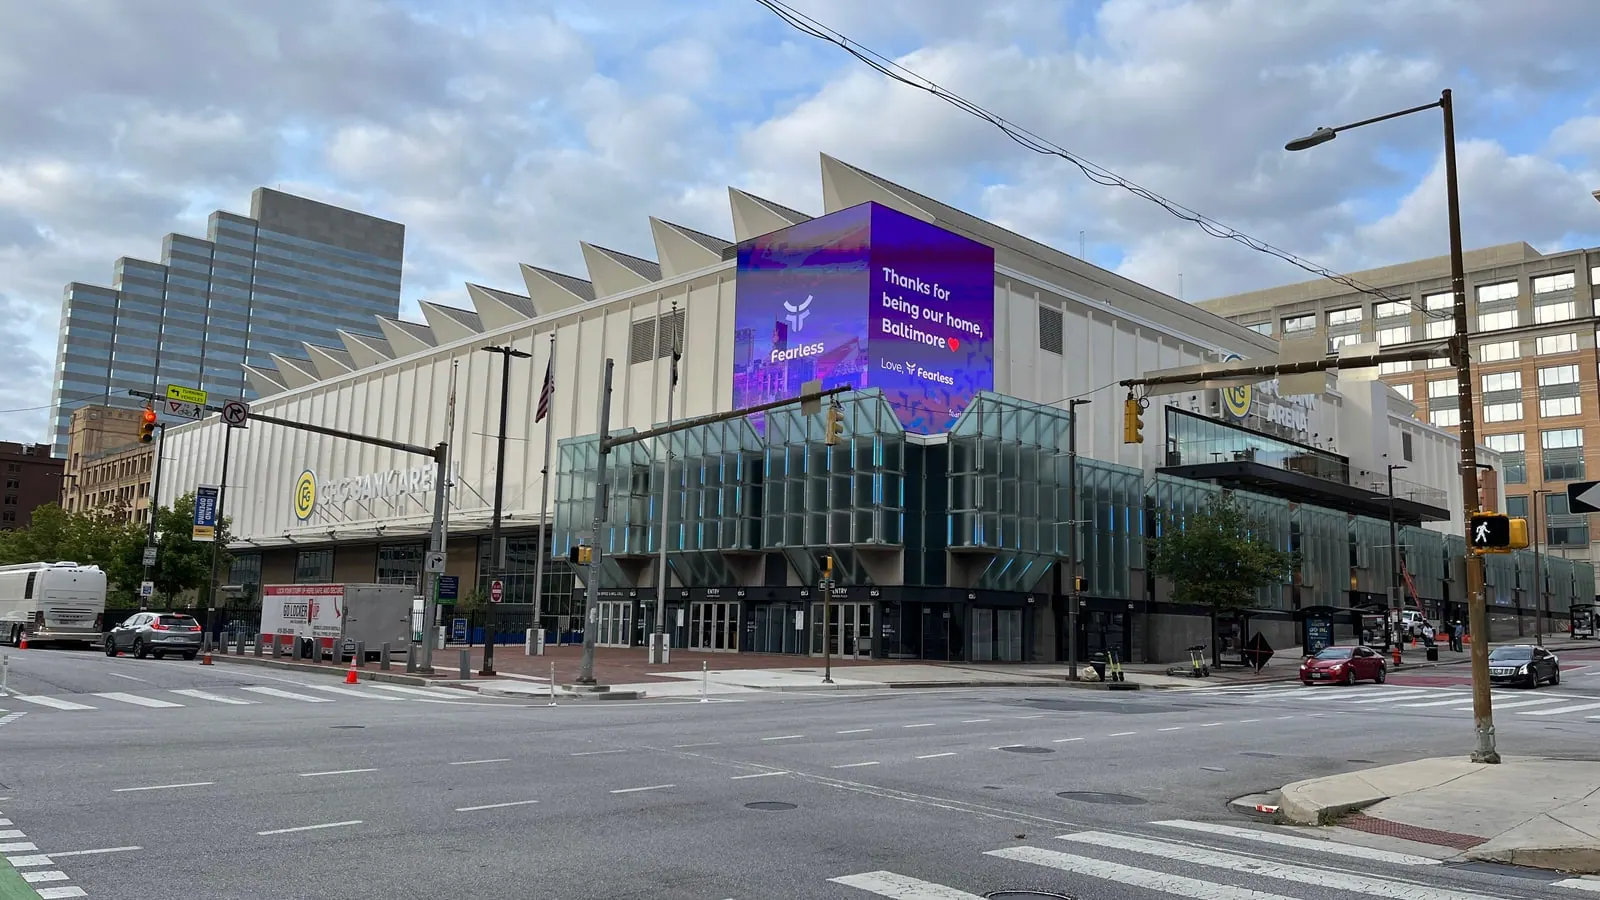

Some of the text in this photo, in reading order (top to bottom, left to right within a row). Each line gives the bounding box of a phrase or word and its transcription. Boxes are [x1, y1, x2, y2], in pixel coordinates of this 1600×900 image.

[883, 267, 950, 301] Thanks for
[882, 292, 983, 338] being our home,
[882, 318, 946, 348] Baltimore
[771, 342, 824, 363] Fearless
[881, 358, 954, 385] Love, Fearless
[180, 395, 204, 403] VEHICLES
[1266, 402, 1309, 433] ARENA
[349, 469, 398, 502] BANK
[197, 497, 206, 525] OPENING
[204, 498, 214, 520] GRAND
[283, 604, 290, 617] GO
[290, 604, 308, 618] LOCKER
